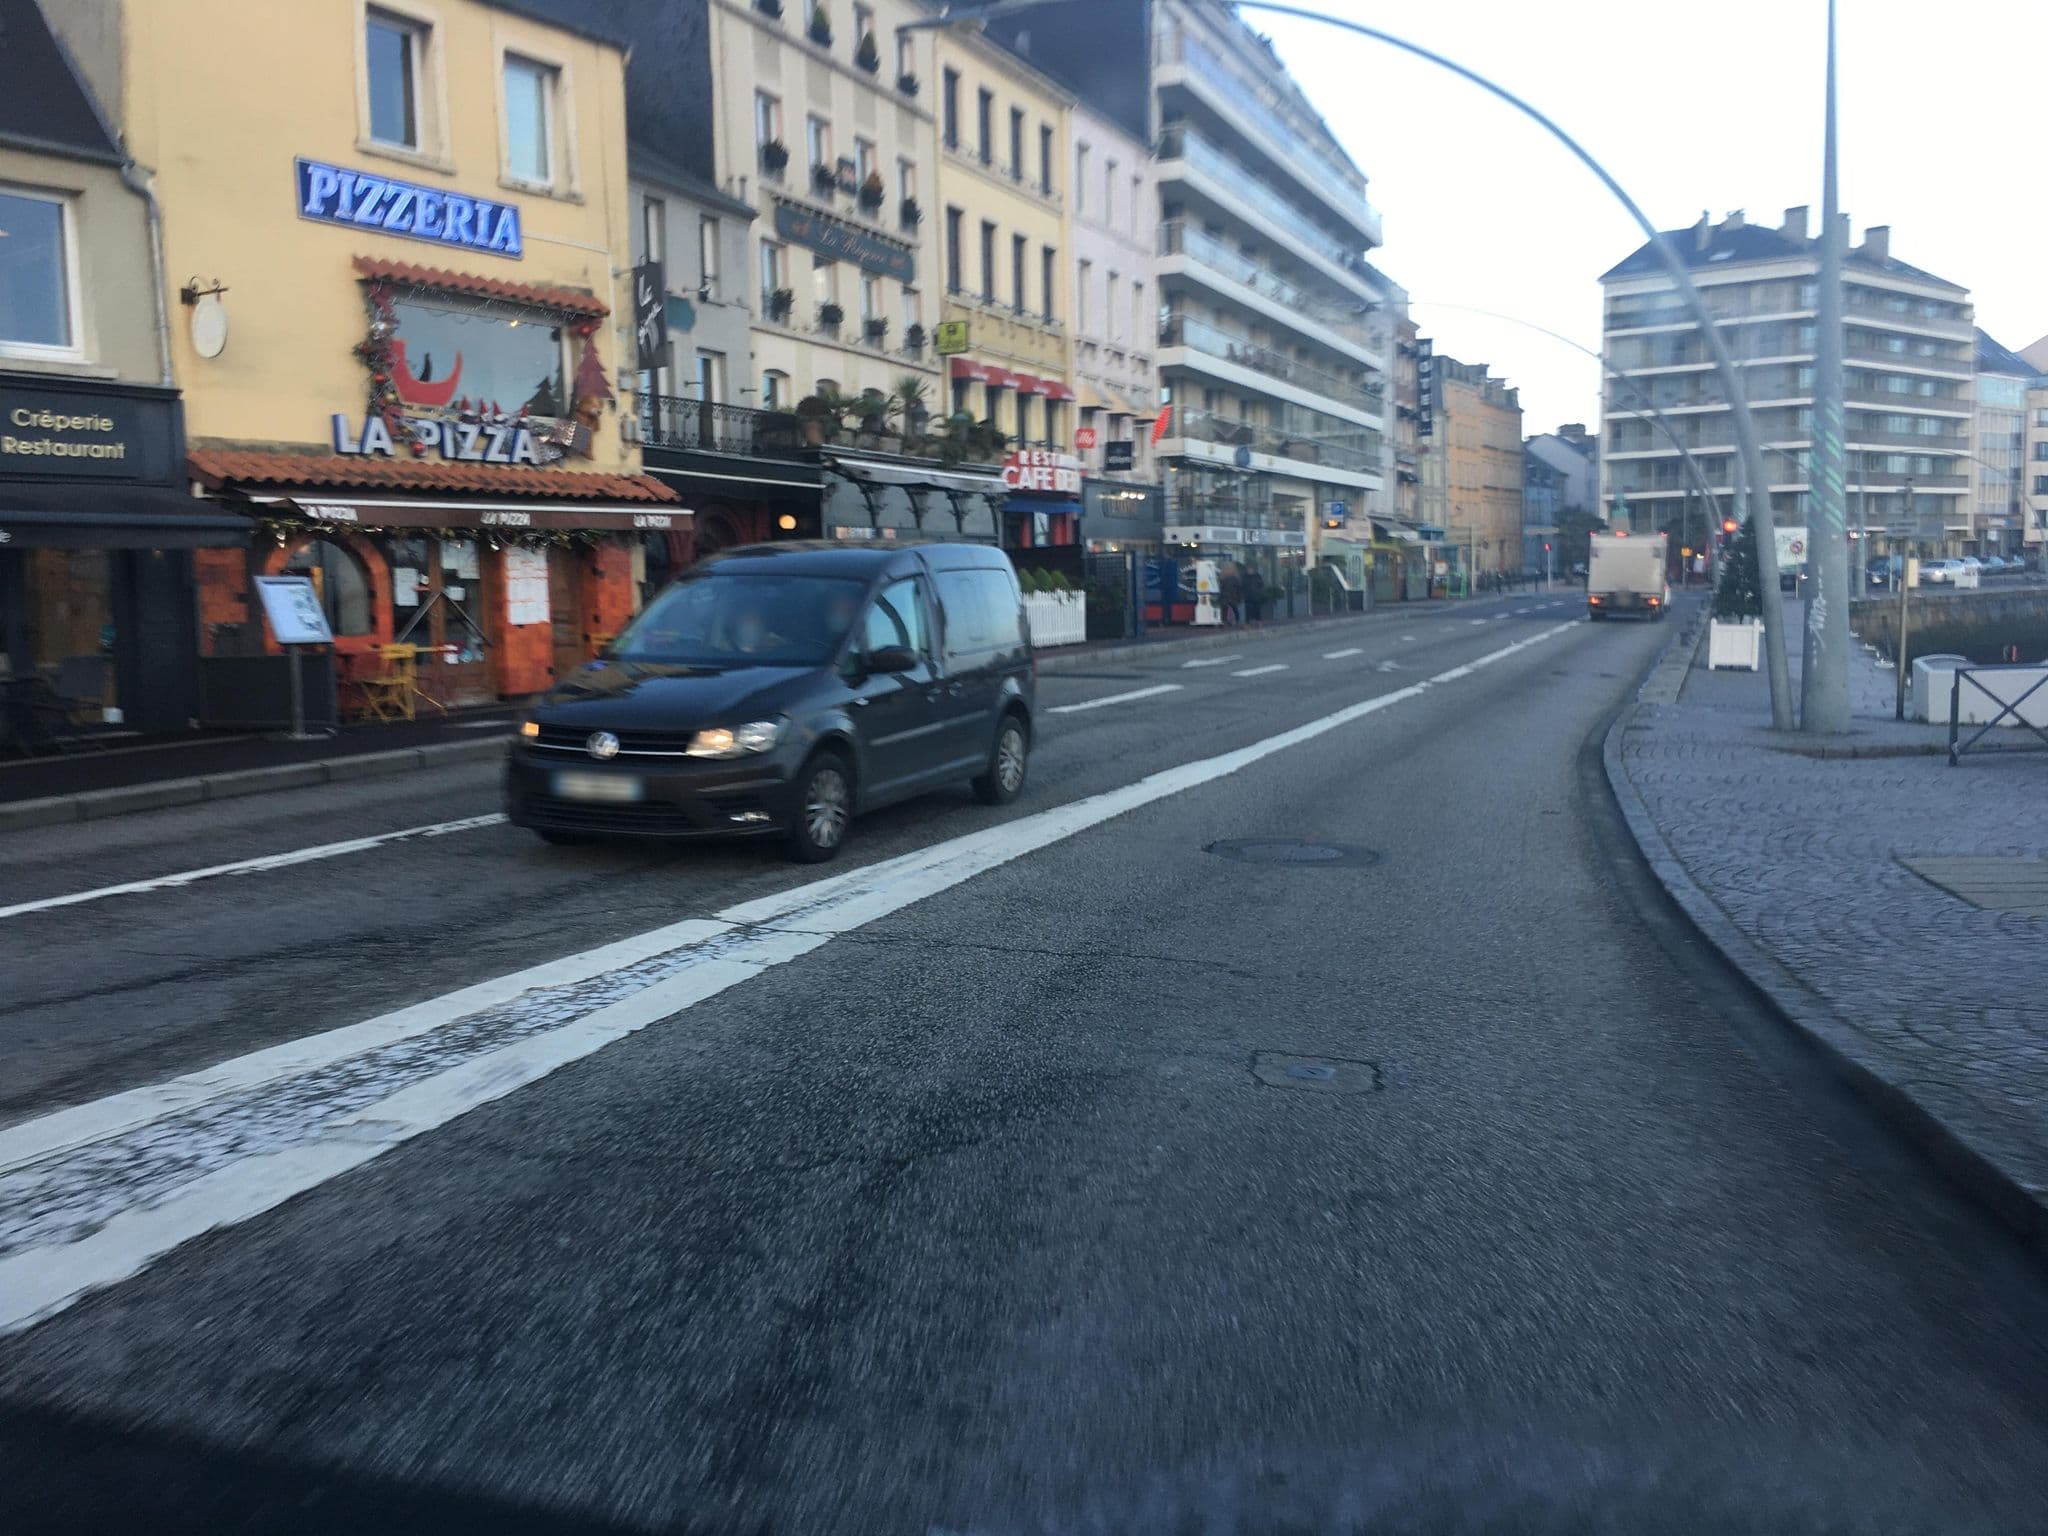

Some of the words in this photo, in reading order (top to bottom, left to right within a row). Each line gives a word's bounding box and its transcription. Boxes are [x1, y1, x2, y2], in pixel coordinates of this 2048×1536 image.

[304, 164, 521, 253] PIZZERIA
[10, 408, 114, 432] Crêperie
[1, 436, 126, 459] Restaurant
[332, 414, 396, 456] LA
[407, 416, 540, 466] PIZZA
